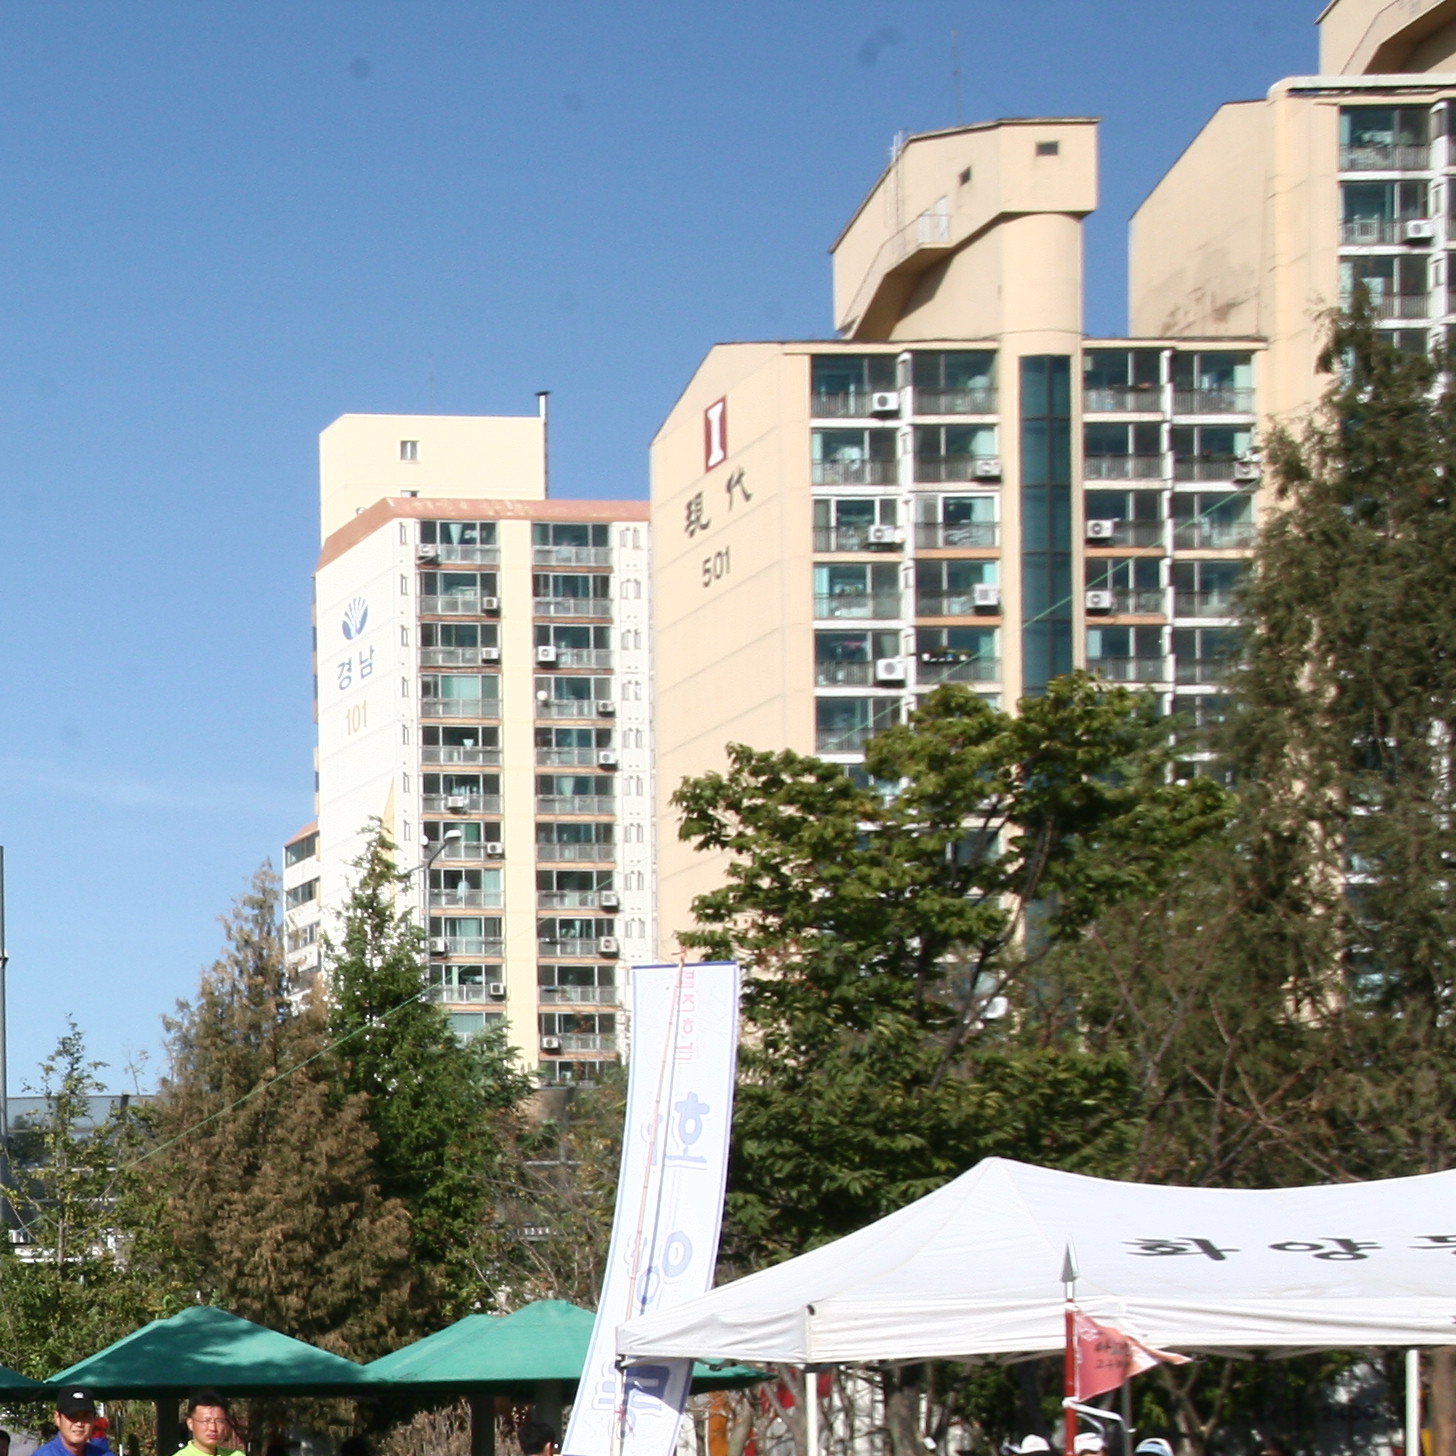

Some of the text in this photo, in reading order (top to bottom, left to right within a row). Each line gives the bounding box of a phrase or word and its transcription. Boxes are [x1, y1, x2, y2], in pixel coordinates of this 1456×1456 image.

[702, 545, 731, 588] 501
[336, 644, 375, 691] 경남
[345, 699, 367, 736] 101
